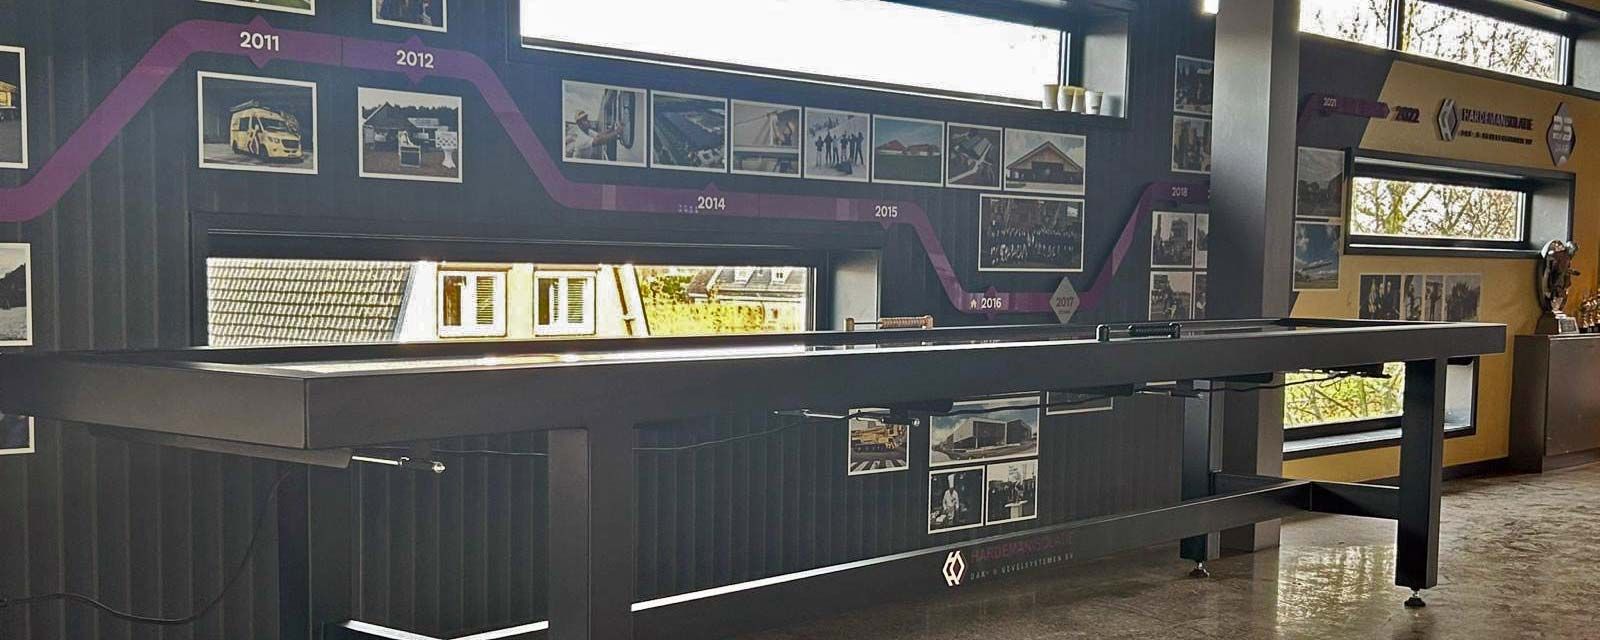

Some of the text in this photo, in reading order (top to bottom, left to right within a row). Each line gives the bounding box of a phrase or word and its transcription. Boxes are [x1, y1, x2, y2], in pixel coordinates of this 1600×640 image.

[240, 31, 280, 51] 2011
[396, 49, 434, 69] 2012
[1171, 187, 1188, 197] 2018
[698, 195, 727, 211] 2014
[875, 205, 898, 218] 2015
[981, 297, 1002, 309] 2016
[1056, 296, 1074, 308] 2017
